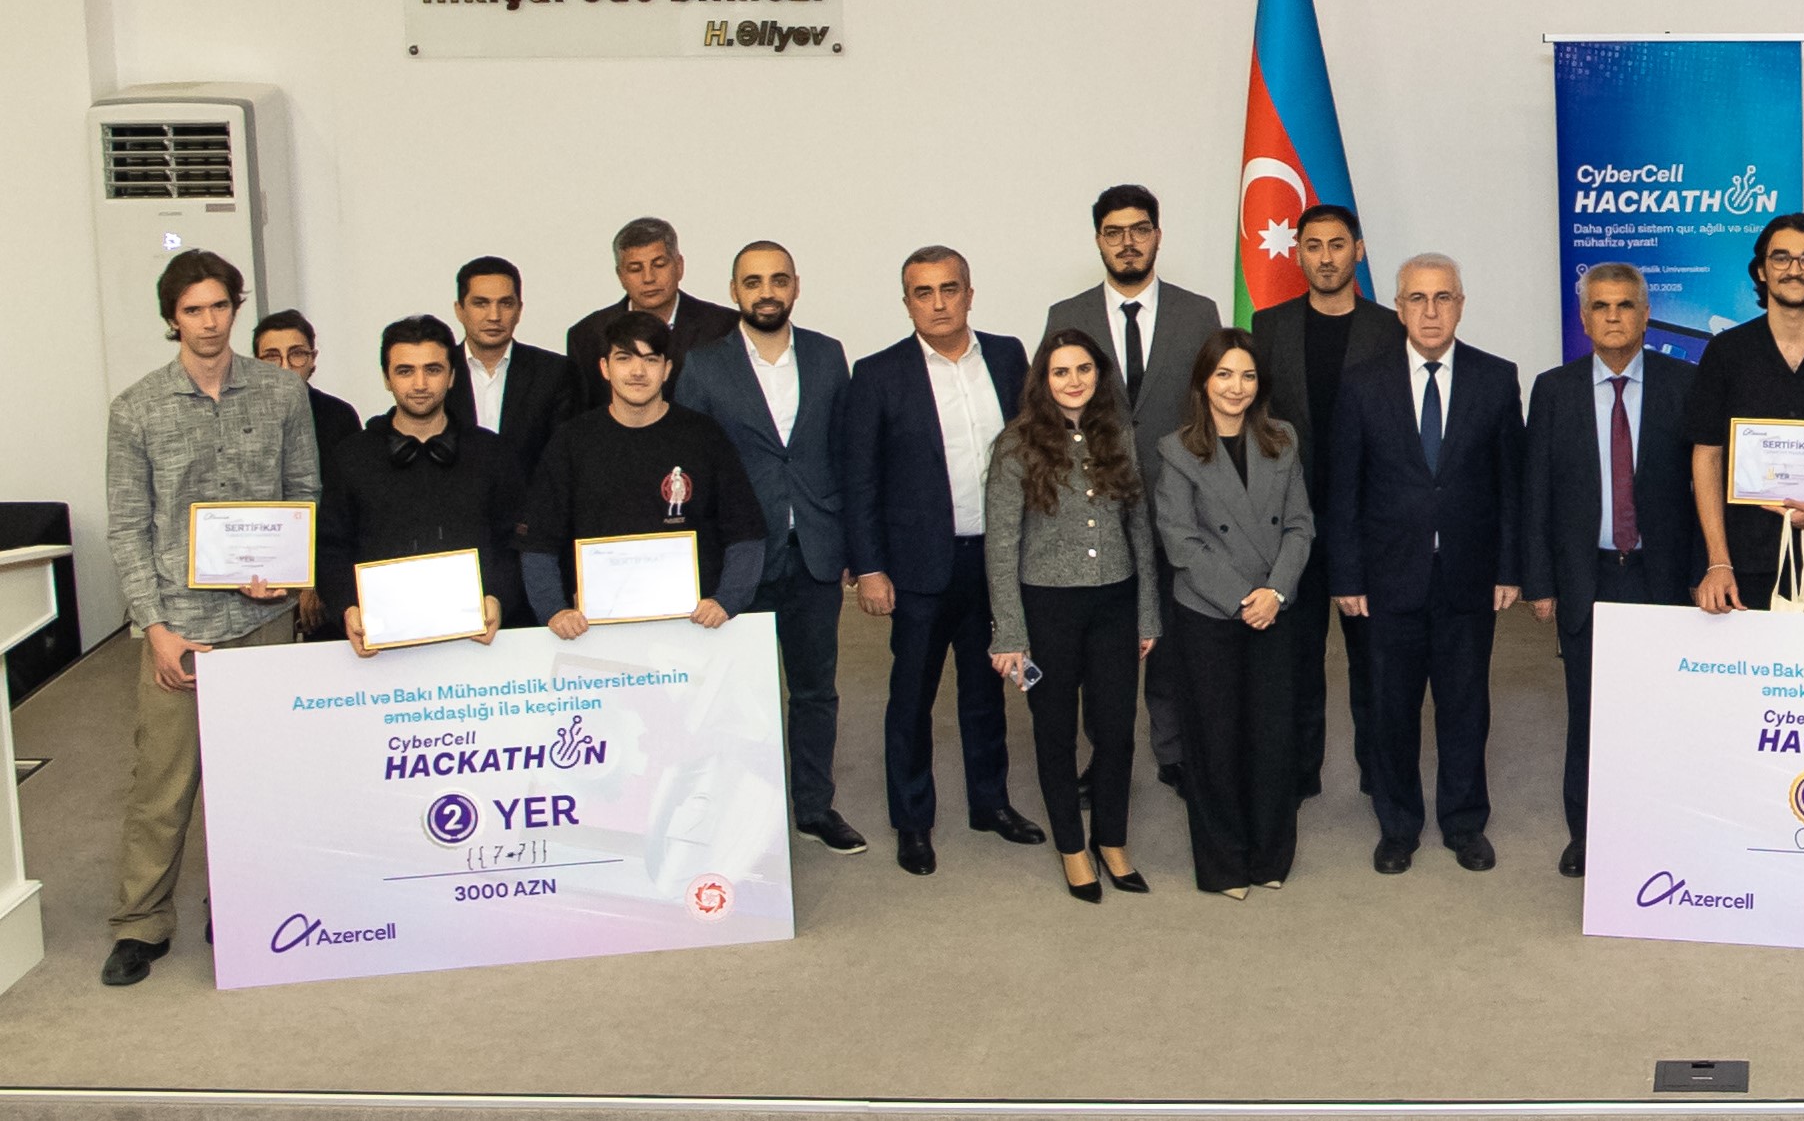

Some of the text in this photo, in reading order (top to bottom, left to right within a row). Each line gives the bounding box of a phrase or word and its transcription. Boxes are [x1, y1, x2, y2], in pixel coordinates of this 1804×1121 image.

[1577, 164, 1684, 188] CyberCell
[1573, 224, 1602, 235] Daha
[1638, 224, 1673, 234] sistem
[1727, 225, 1742, 234] və
[1627, 237, 1658, 249] yarat!
[225, 522, 283, 532] SERTİFİKAT
[1678, 658, 1747, 675] Azercell
[1751, 665, 1770, 675] və
[292, 669, 688, 711] Azercell və Bakı Mühəndislik Universitetinin
[384, 696, 602, 724] əməkdaşlığı ilə keçirilən
[388, 731, 476, 753] CyberCell
[444, 795, 580, 831] 2 YER
[454, 879, 556, 902] 3000 AZN
[1679, 890, 1754, 911] Azercell
[316, 923, 396, 945] Azercell
